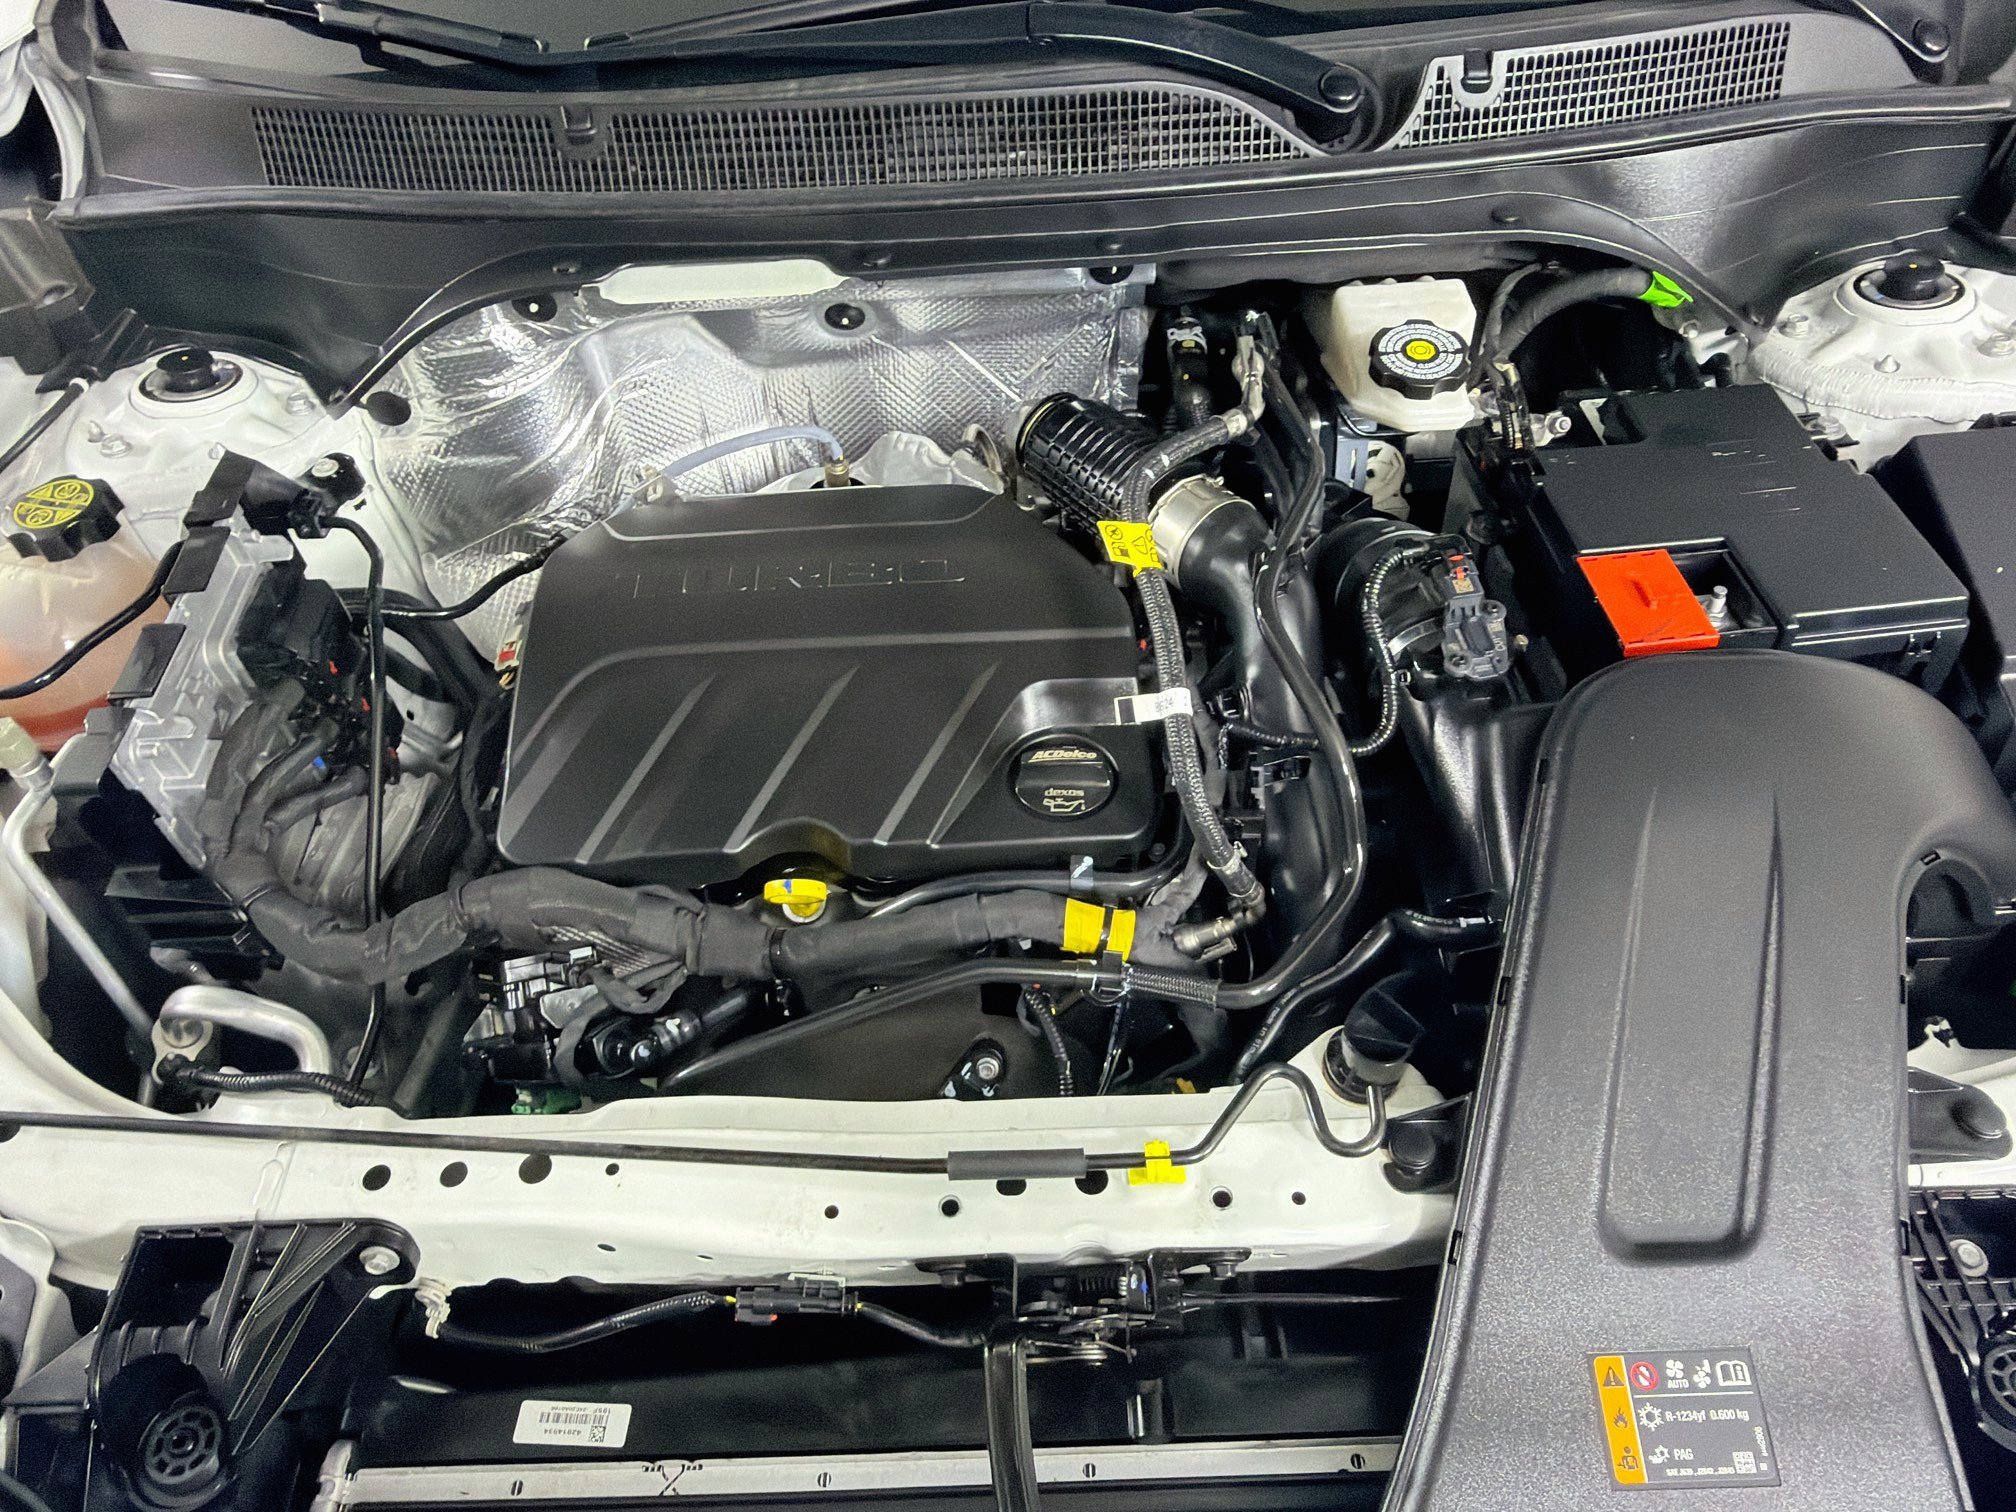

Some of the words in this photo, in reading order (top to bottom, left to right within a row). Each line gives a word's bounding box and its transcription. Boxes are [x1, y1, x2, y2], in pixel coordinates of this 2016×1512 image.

[1028, 749, 1098, 762] ACDelco
[1044, 787, 1085, 797] dexos
[1667, 1379, 1690, 1389] AUTO
[1665, 1409, 1707, 1423] R-1234yf
[1709, 1408, 1736, 1421] 0.600
[1736, 1408, 1750, 1422] kg
[1673, 1448, 1694, 1461] PAG
